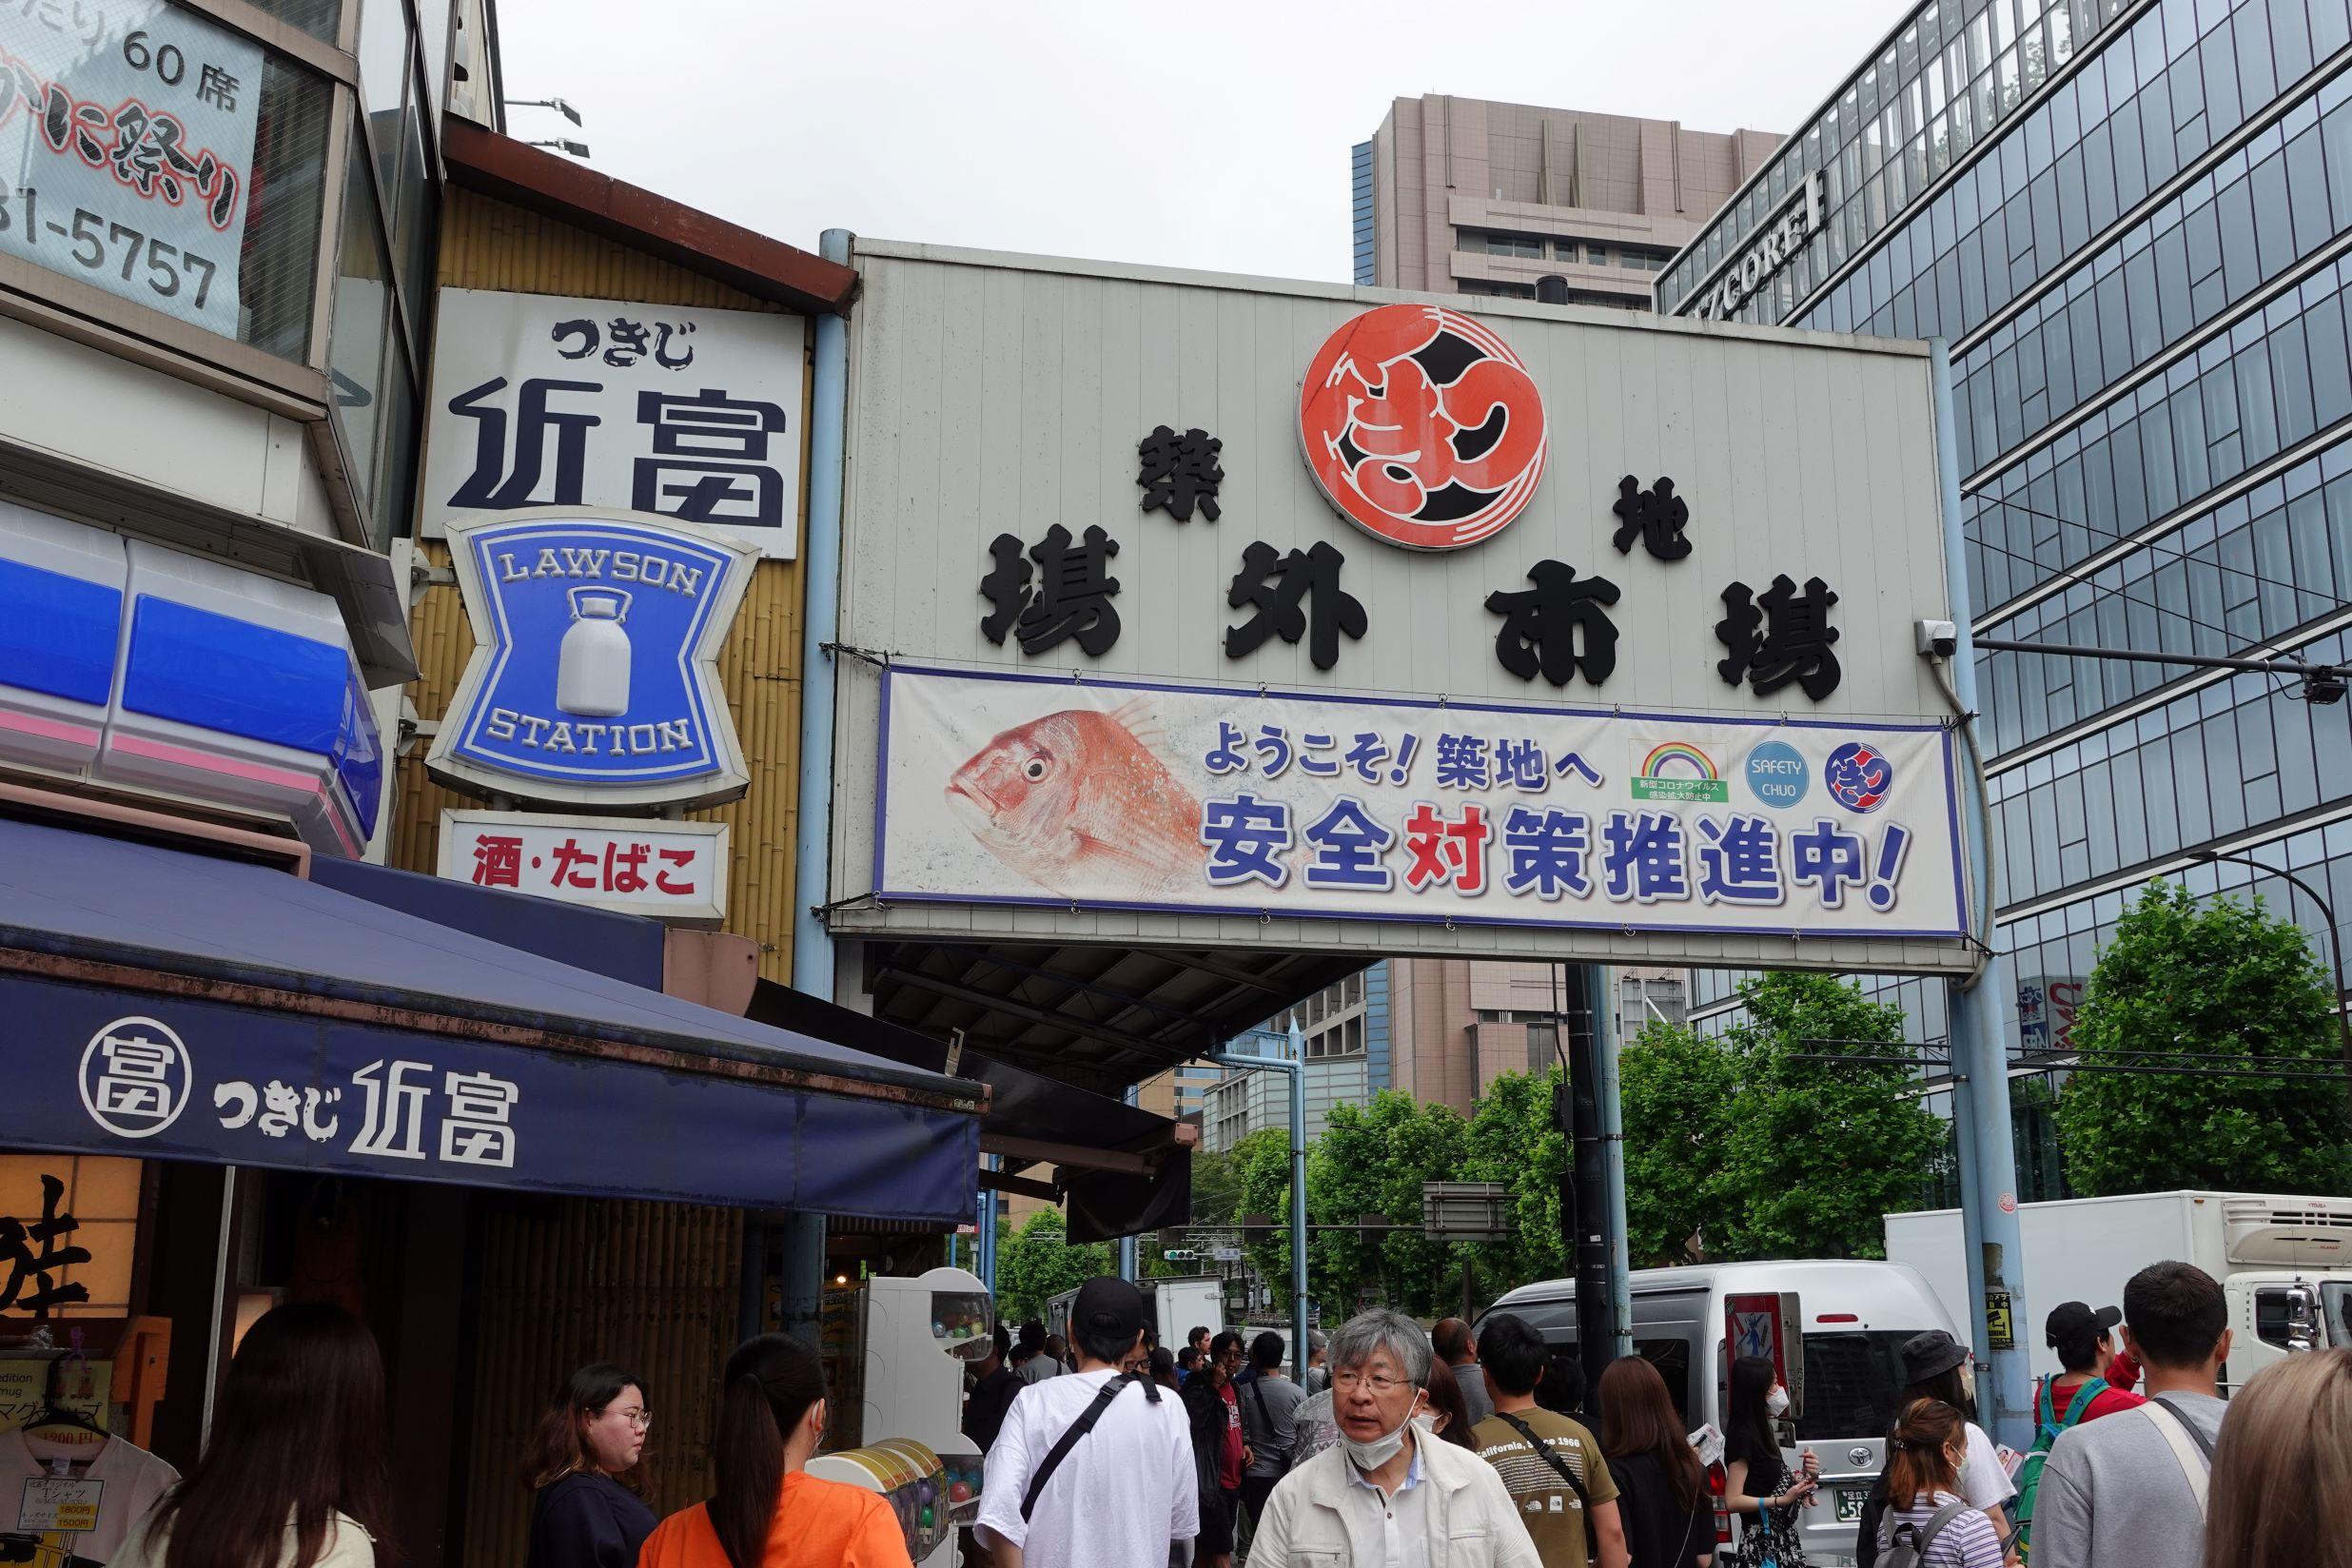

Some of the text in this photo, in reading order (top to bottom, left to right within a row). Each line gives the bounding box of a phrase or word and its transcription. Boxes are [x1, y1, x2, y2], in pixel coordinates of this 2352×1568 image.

[551, 317, 697, 371] つきじ
[498, 547, 704, 598] LAWSON
[485, 707, 694, 756] STATION
[1752, 759, 1802, 775] SAFETY
[1639, 779, 1720, 792] 新型コロナウイルス
[1649, 791, 1711, 801] 感染拡大防止中
[1761, 782, 1796, 796] CHUO
[472, 833, 696, 894] 酒・たばこ
[1202, 793, 1909, 907] 安全対策推進中!
[1558, 1437, 1580, 1448] 1966
